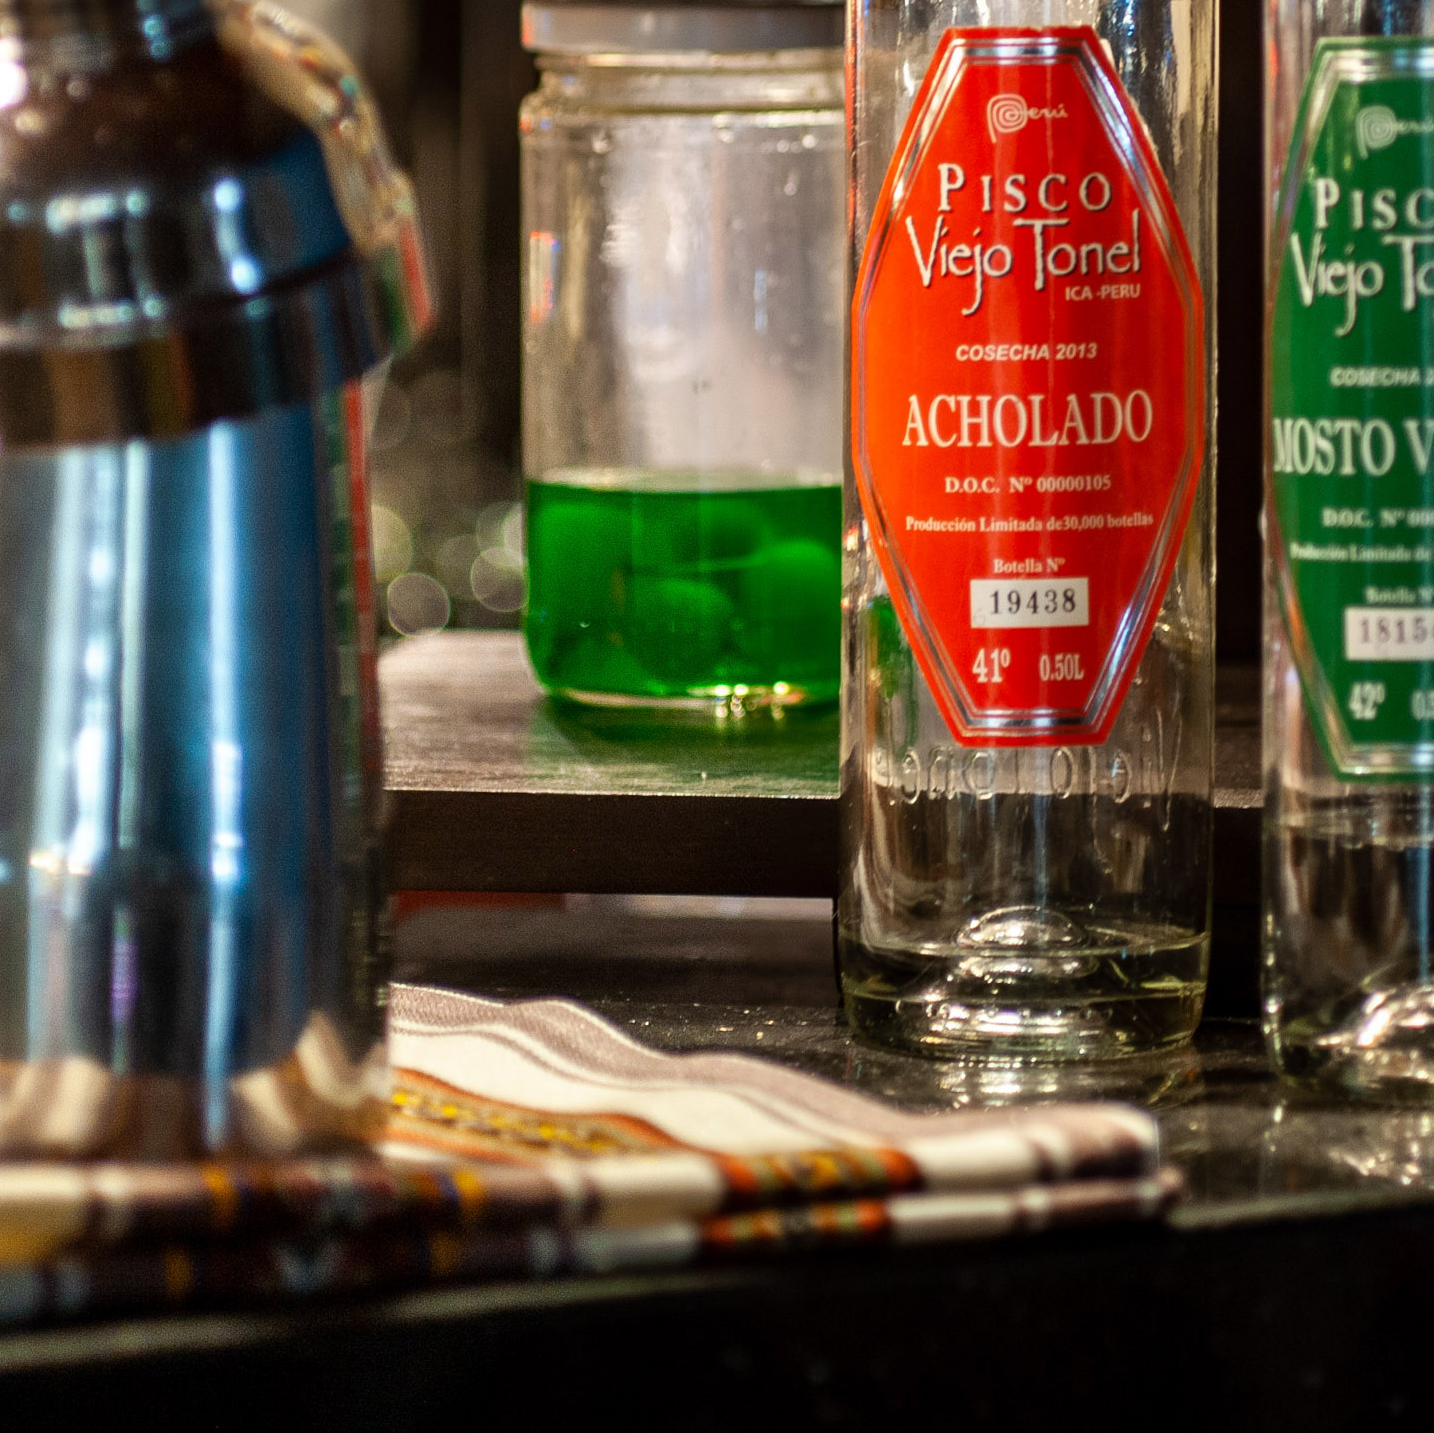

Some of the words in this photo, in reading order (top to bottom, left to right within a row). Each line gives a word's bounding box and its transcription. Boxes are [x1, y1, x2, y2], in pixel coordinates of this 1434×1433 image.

[938, 163, 1112, 213] PISCO
[905, 216, 1012, 316] Viejo
[1013, 209, 1141, 291] Tonel
[1065, 286, 1093, 301] ICA
[1290, 232, 1385, 338] Viejo
[956, 343, 1050, 361] COSECHA
[1056, 342, 1098, 360] 2013
[1329, 366, 1421, 387] COSECHA
[902, 390, 1153, 447] ACHOLADO
[1272, 418, 1396, 477] MOSTO
[945, 477, 1001, 494] D.O.C.
[1036, 475, 1111, 492] 00000105
[905, 516, 976, 532] Producción
[979, 517, 1043, 532] Limitada
[1107, 512, 1154, 529] botellas
[993, 558, 1042, 574] Botella
[989, 588, 1077, 615] 19438
[1038, 653, 1085, 681] 0.50L
